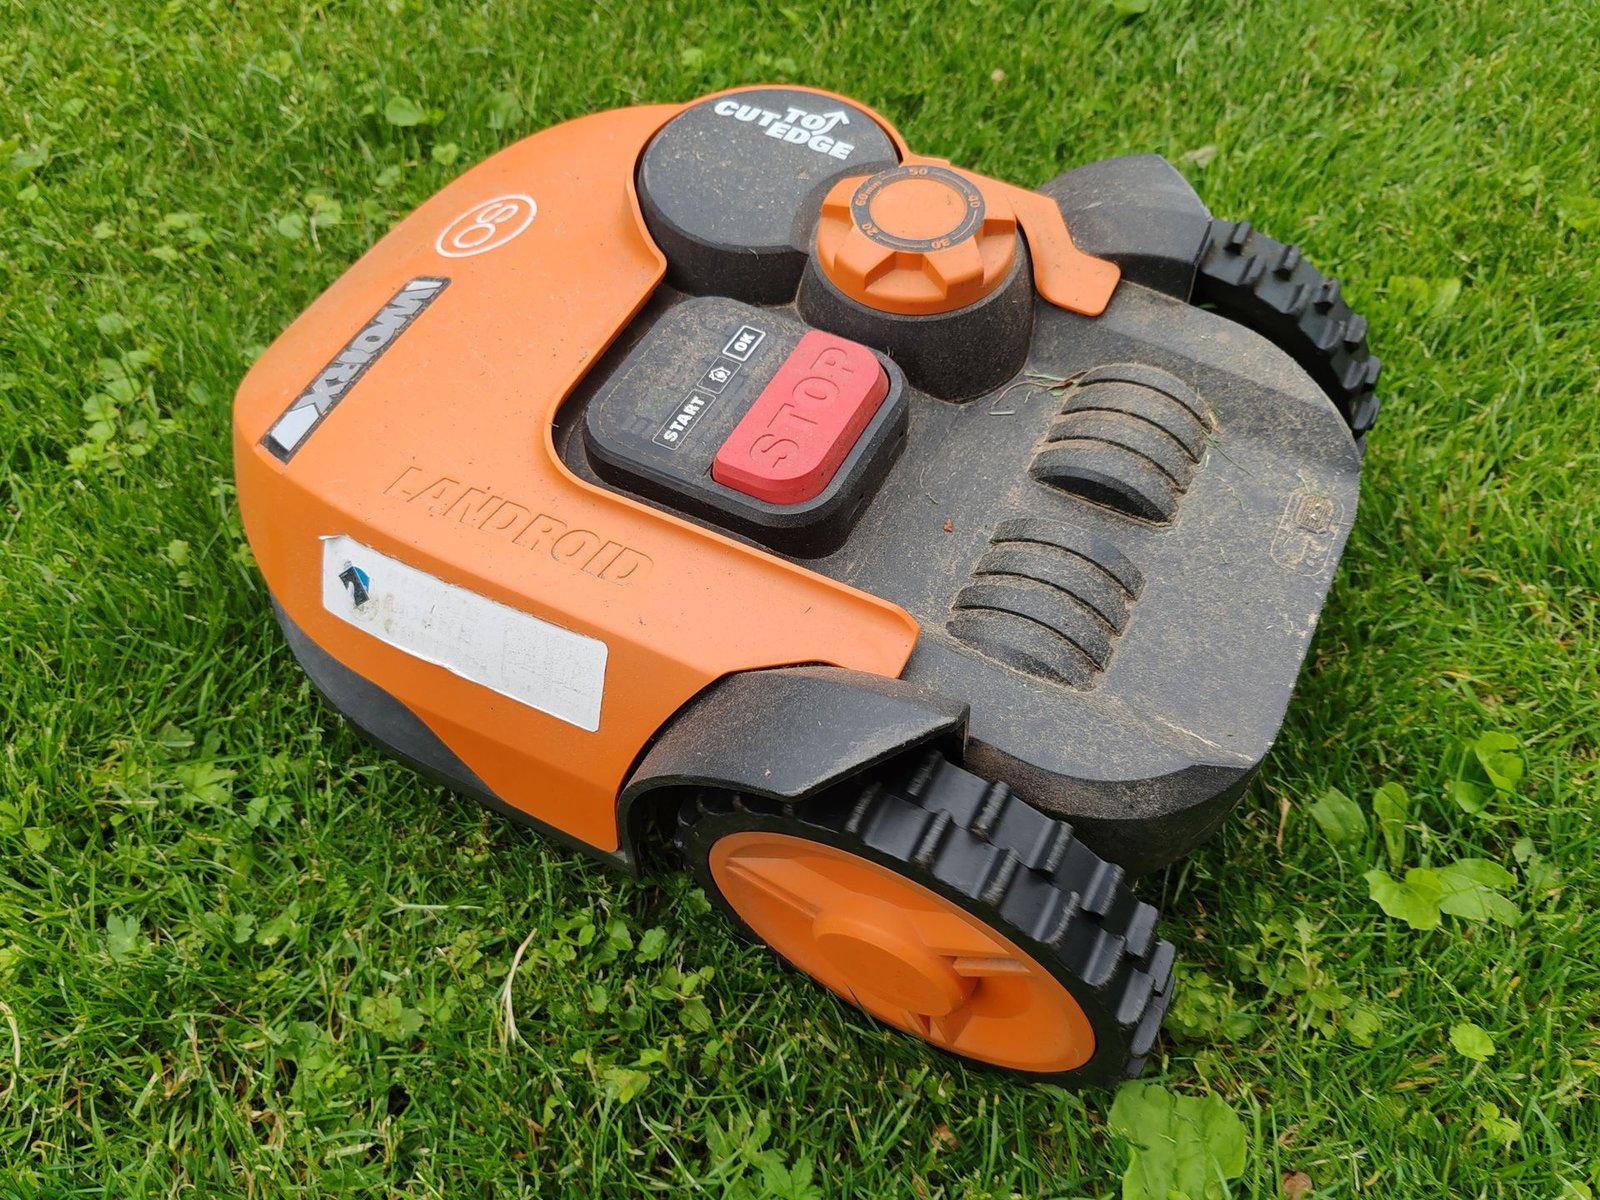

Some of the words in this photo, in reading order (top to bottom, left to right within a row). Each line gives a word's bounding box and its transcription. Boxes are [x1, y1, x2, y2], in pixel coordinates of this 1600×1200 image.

[714, 101, 781, 127] CUT
[786, 107, 826, 129] TO
[765, 121, 855, 160] EDGE
[908, 167, 928, 176] 50
[288, 280, 443, 420] WORX
[734, 333, 756, 352] OK
[663, 396, 705, 442] START
[749, 347, 854, 469] STOP
[383, 466, 654, 585] LANDROID
